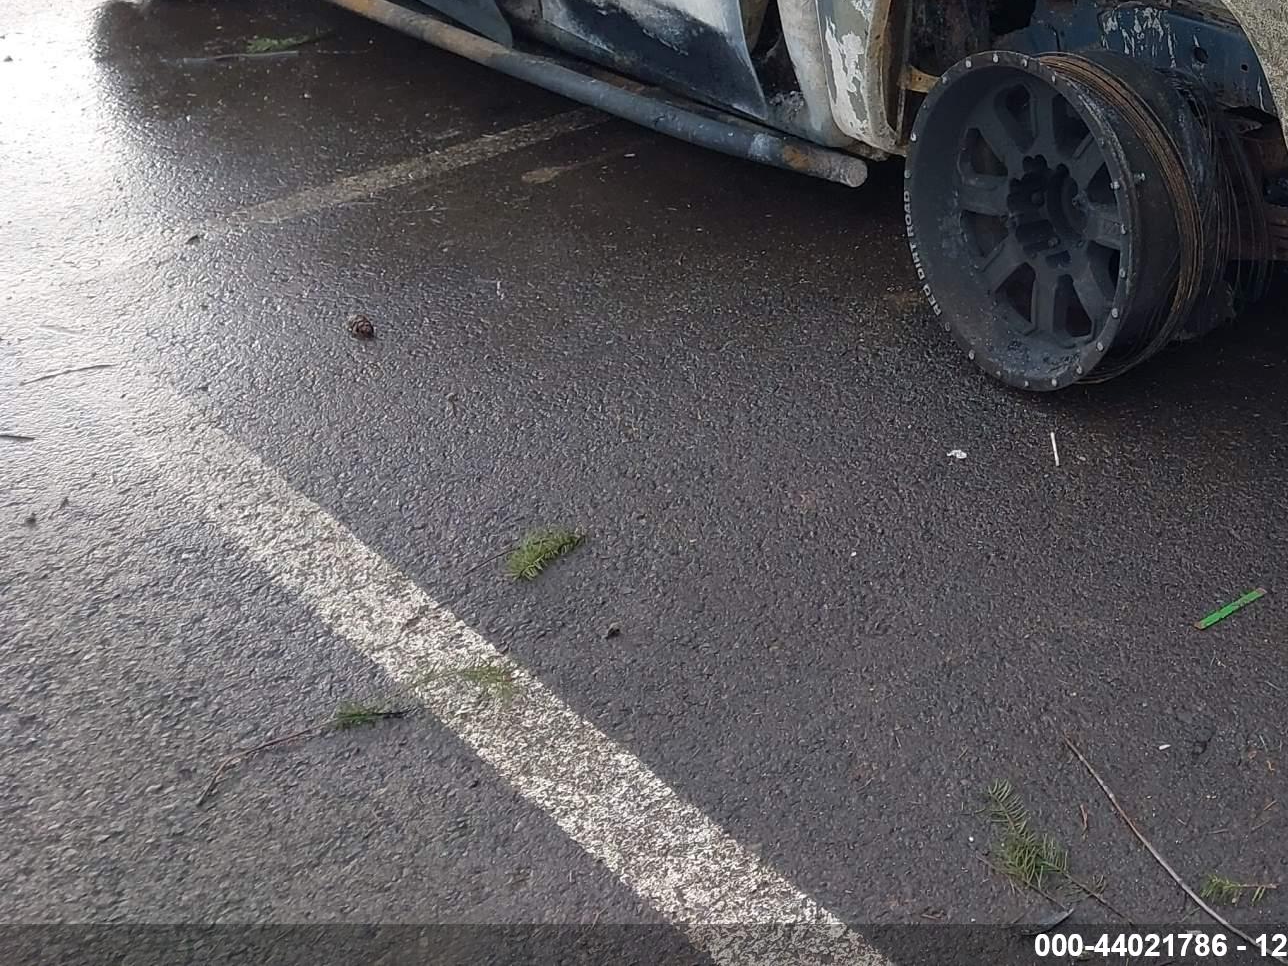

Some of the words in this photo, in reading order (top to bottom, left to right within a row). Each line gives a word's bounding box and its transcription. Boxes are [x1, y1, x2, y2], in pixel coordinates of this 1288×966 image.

[903, 190, 914, 237] ROAD
[909, 241, 926, 281] DIRT
[922, 283, 942, 316] RED
